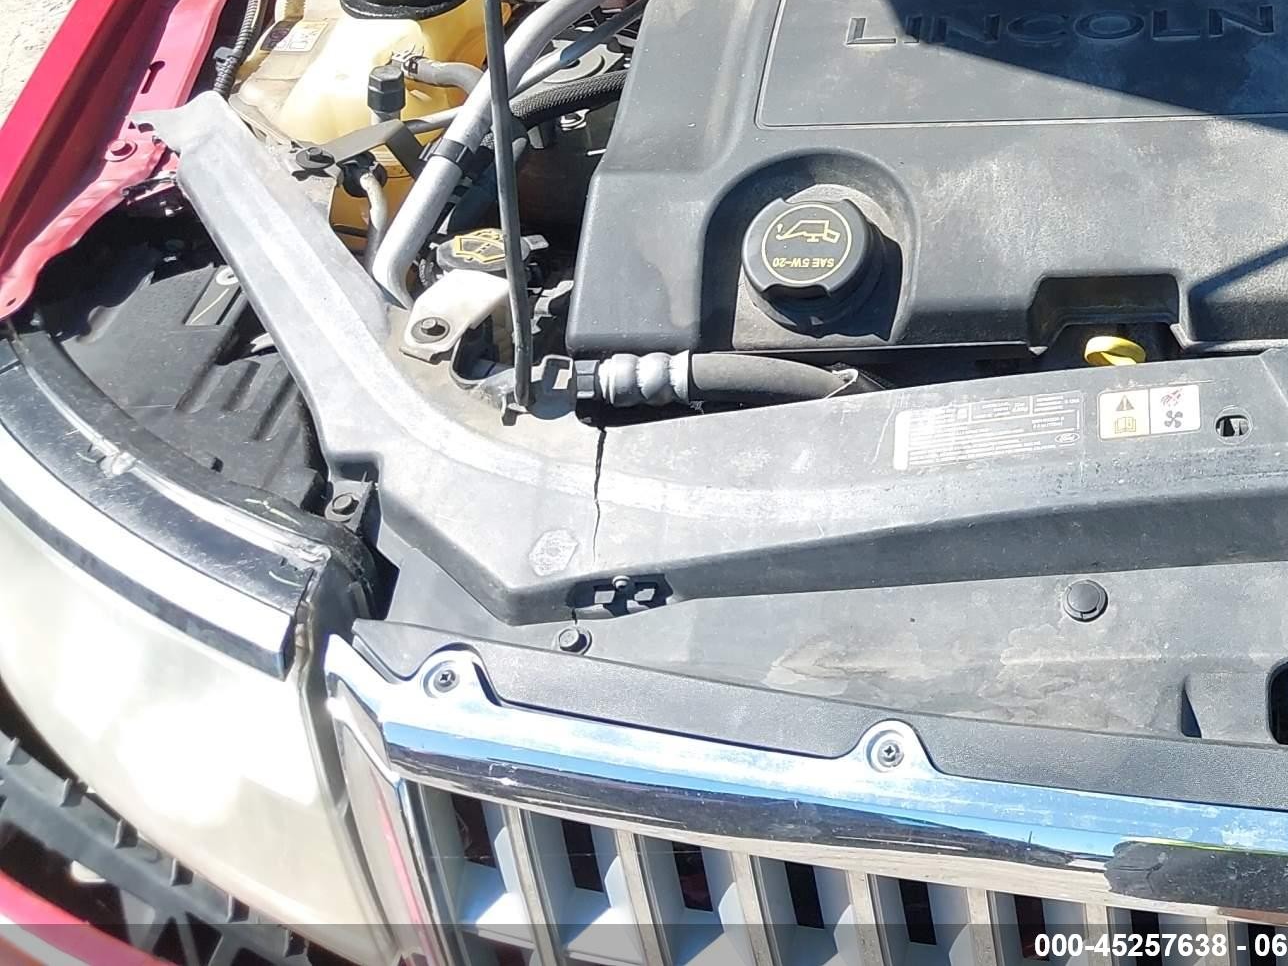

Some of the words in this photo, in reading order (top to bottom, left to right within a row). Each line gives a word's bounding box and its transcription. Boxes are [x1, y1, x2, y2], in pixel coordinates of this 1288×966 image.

[845, 4, 1276, 46] LINCOLN
[772, 258, 811, 268] 5W-20
[812, 258, 835, 268] SAE
